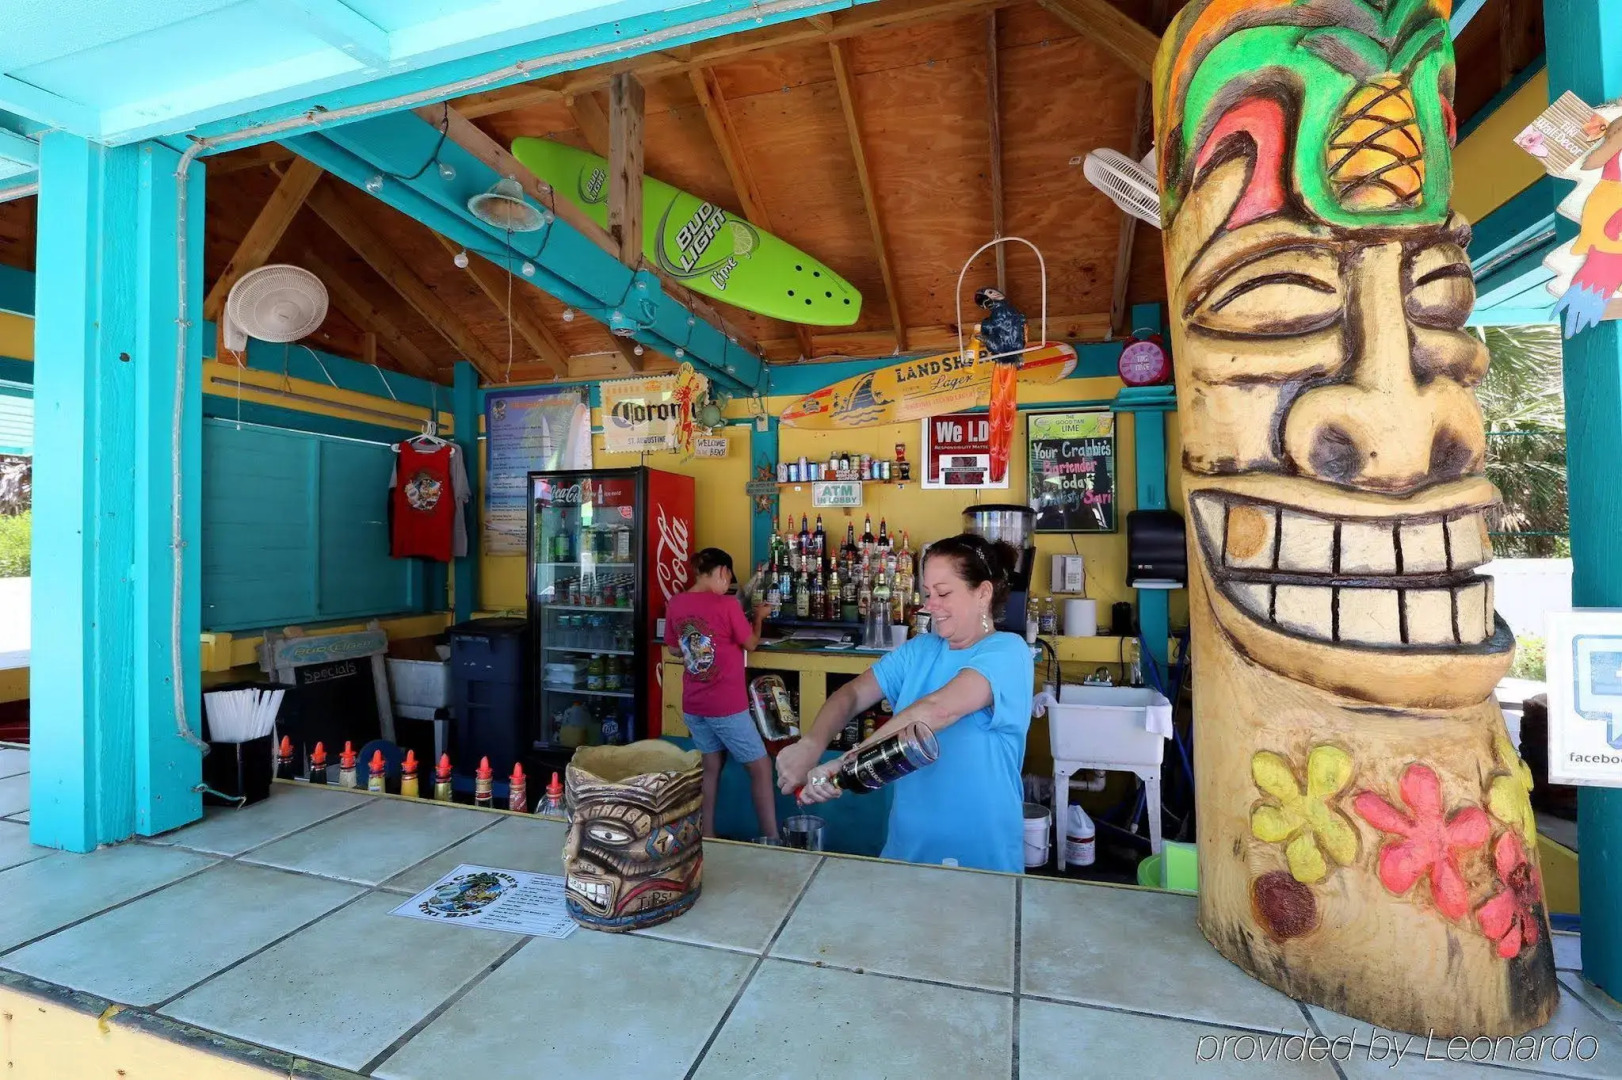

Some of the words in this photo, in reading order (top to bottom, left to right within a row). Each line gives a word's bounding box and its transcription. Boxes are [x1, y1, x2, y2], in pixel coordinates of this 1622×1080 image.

[587, 168, 600, 192] BUD
[590, 170, 607, 200] LIGHT
[675, 201, 714, 251] BUD
[679, 206, 728, 273] LIGHT
[710, 256, 738, 291] Lime
[930, 374, 974, 391] Lager
[637, 435, 666, 445] AUGUSTINE
[936, 421, 963, 443] We
[1033, 442, 1059, 459] Your
[1062, 439, 1111, 458] Crabbie's
[1043, 457, 1098, 474] Bartender
[822, 484, 853, 496] ATM
[829, 496, 857, 504] LOBBY
[304, 661, 357, 682] Specials
[1569, 752, 1622, 764] facebo
